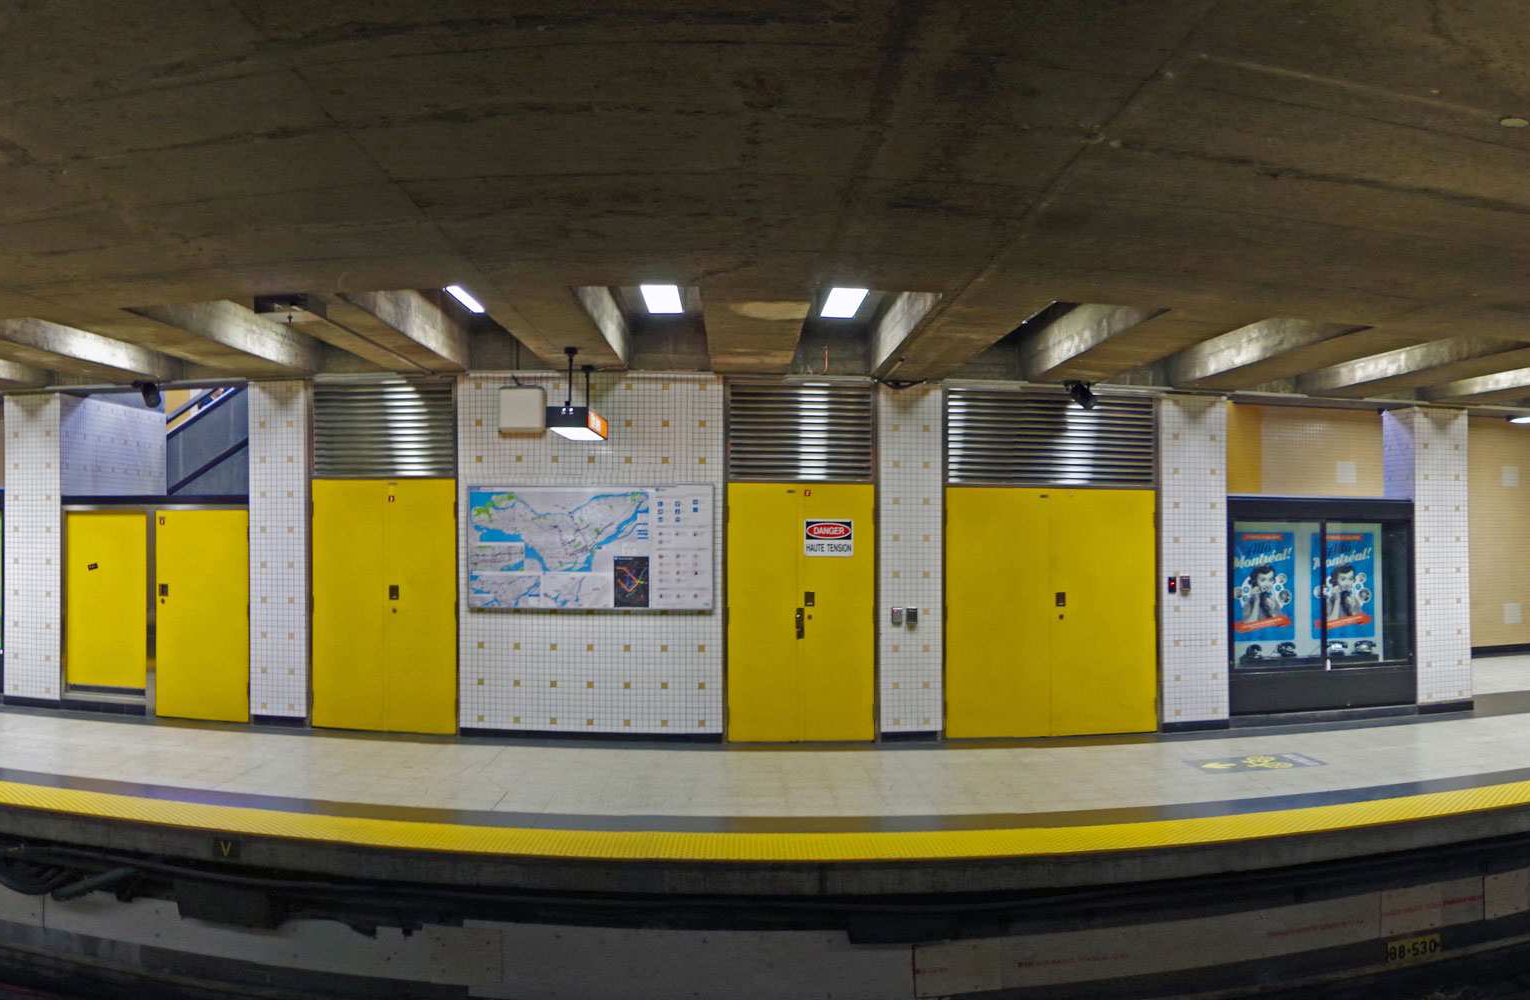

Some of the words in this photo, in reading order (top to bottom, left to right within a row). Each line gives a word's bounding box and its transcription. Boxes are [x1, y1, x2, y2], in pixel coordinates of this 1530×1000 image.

[813, 526, 845, 535] DANGER
[806, 544, 825, 552] HAUTE
[827, 544, 852, 553] TENSION
[1247, 541, 1272, 557] Allô
[1234, 547, 1293, 569] Montréal!
[220, 841, 232, 857] V
